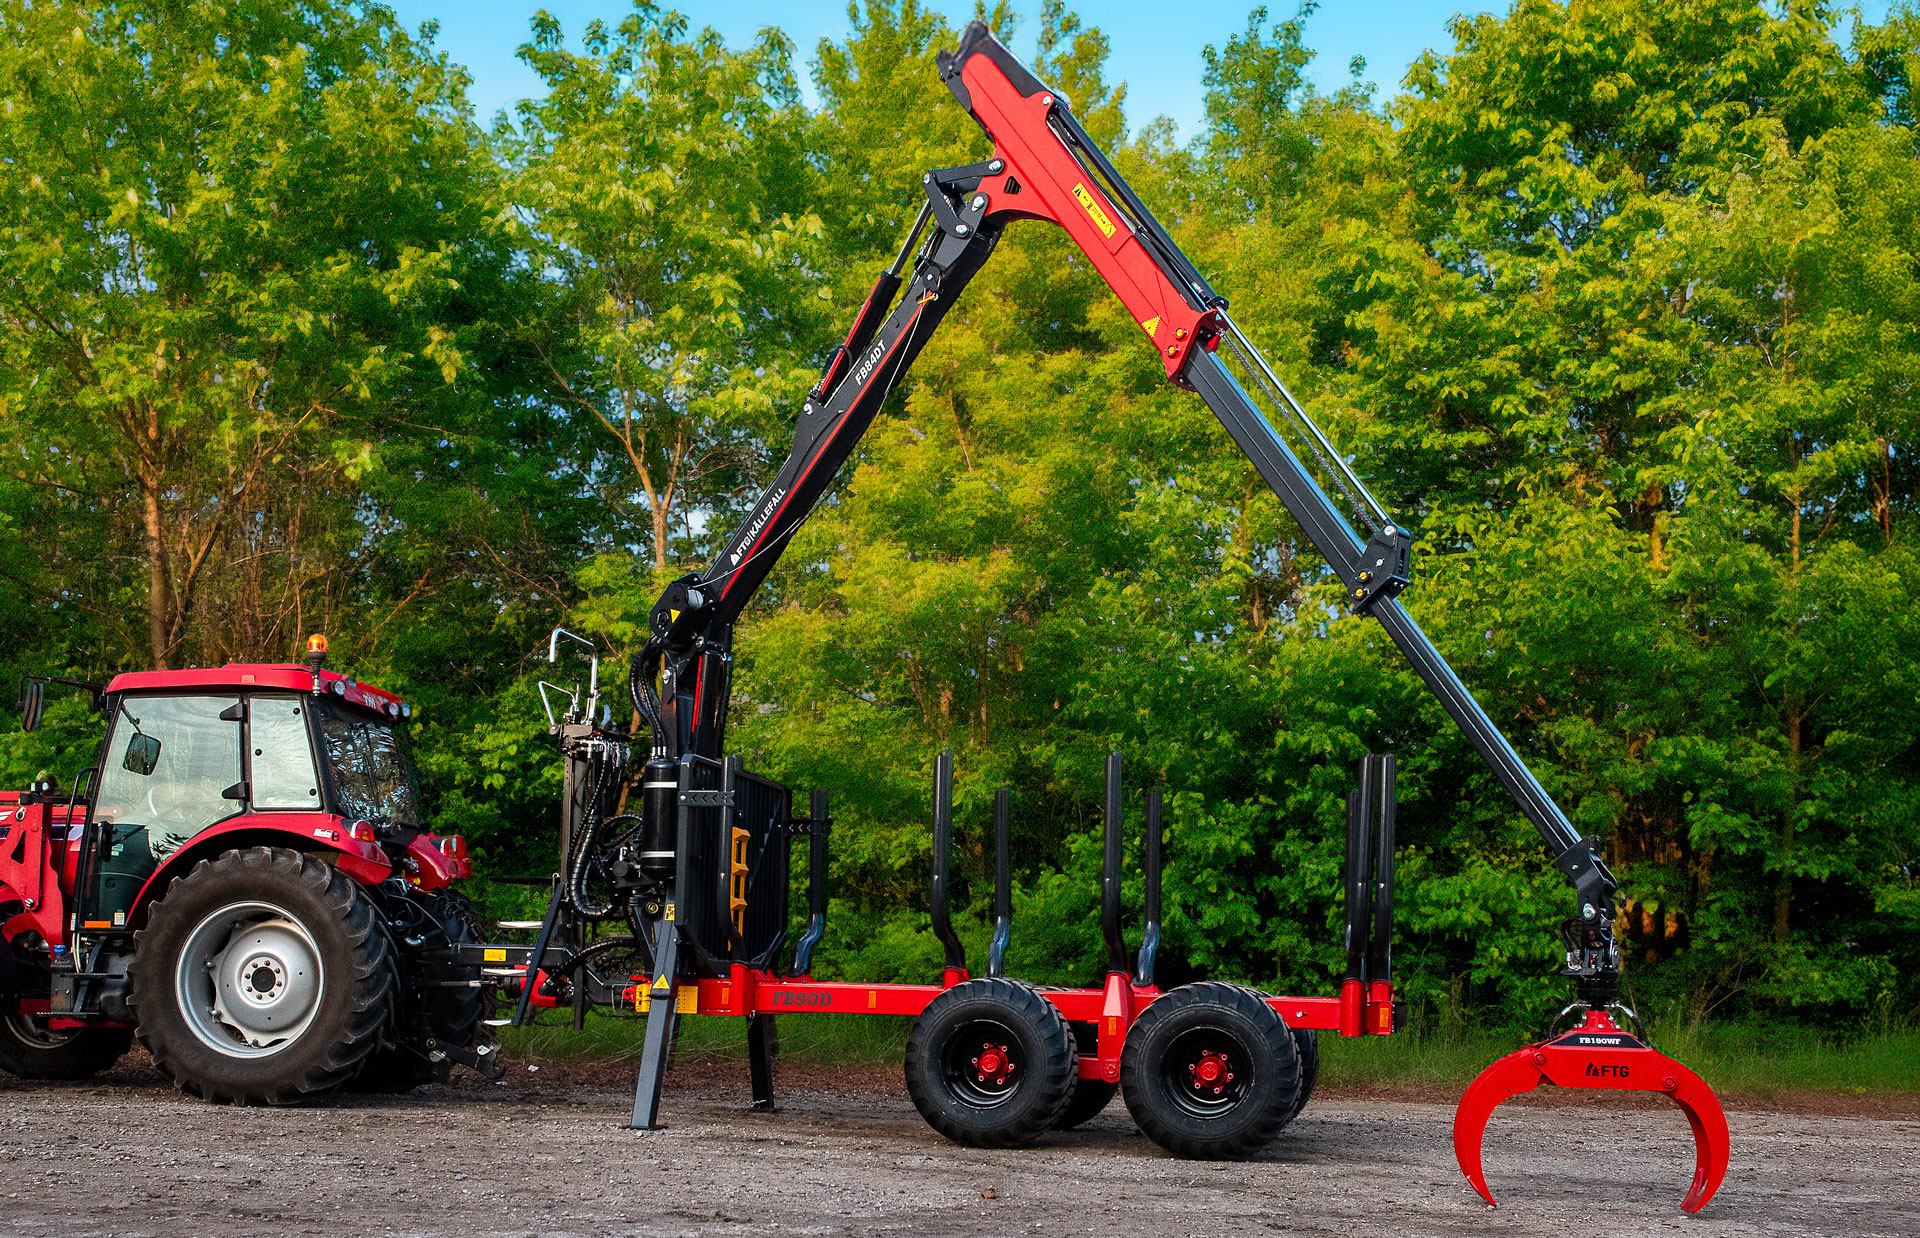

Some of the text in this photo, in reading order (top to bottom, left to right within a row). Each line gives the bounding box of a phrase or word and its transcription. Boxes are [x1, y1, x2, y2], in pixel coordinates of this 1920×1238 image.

[855, 339, 886, 386] FB84DT
[772, 991, 832, 1006] FB90D
[1601, 1065, 1630, 1077] FTG
